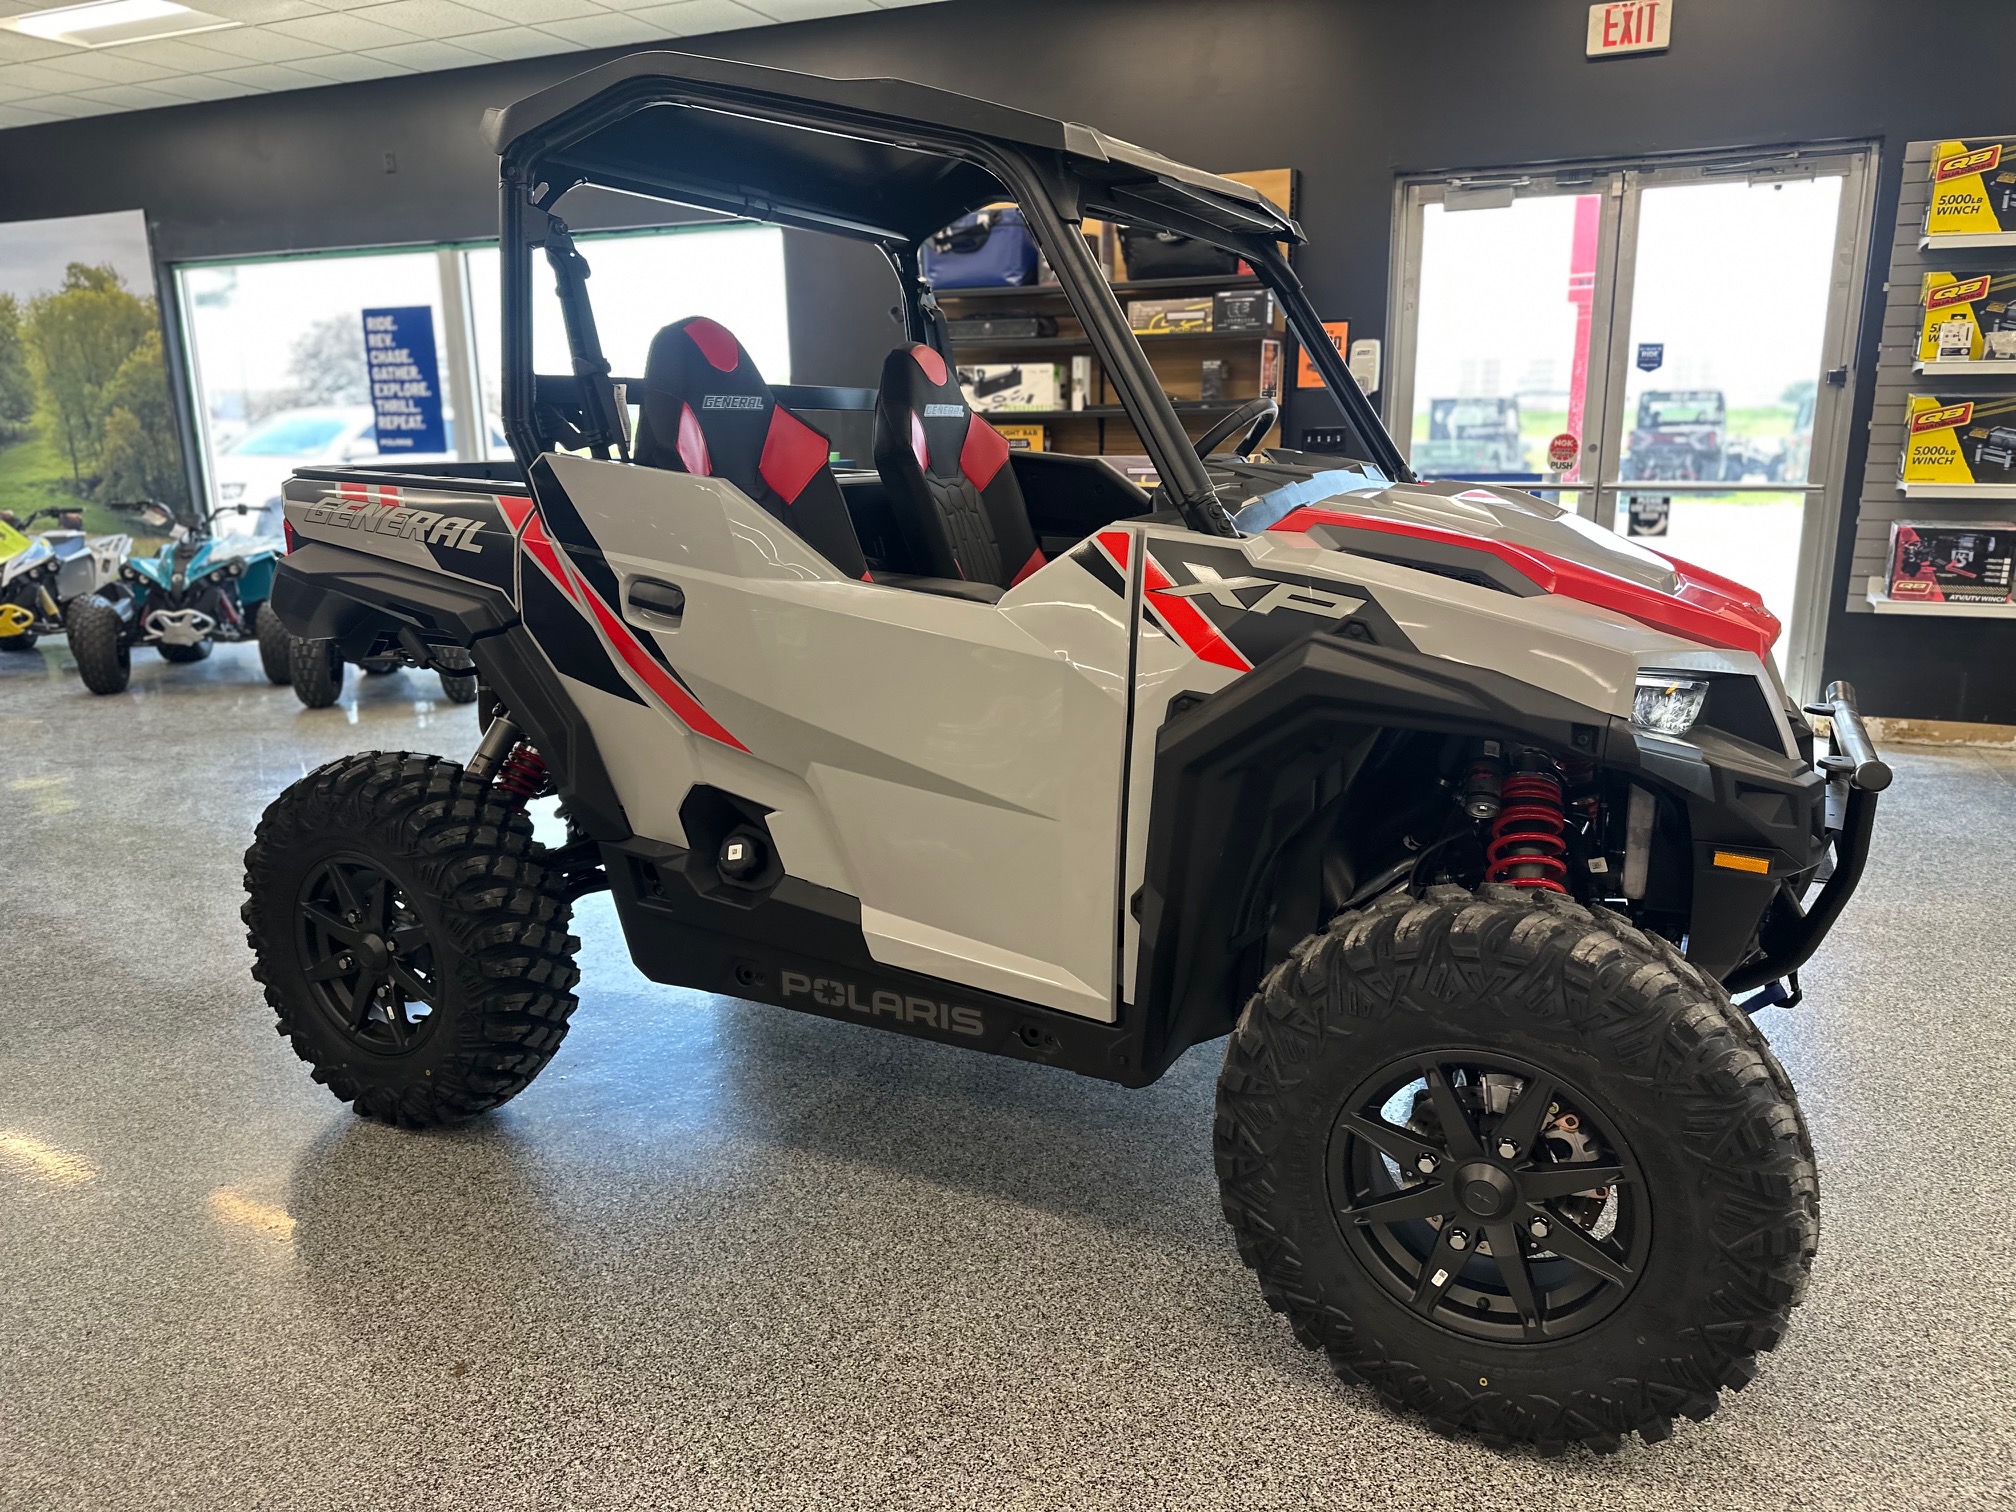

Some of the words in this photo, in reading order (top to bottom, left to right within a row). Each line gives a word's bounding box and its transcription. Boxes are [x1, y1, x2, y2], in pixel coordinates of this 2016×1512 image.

[1603, 1, 1660, 47] EXIT
[1940, 161, 1993, 179] QUADBOSS
[1937, 205, 1980, 216] WINCH
[1932, 292, 1982, 308] QUADBOSS
[703, 395, 763, 409] GENERAL
[924, 404, 965, 418] GENERAL
[1916, 418, 1966, 432] QUADBOSS
[1550, 461, 1573, 469] PUSH
[1912, 456, 1954, 465] WINCH
[304, 497, 486, 554] GENERAL
[1153, 561, 1367, 620] XP
[1949, 594, 1981, 602] ATV/UTV
[781, 970, 984, 1036] POLARIS
